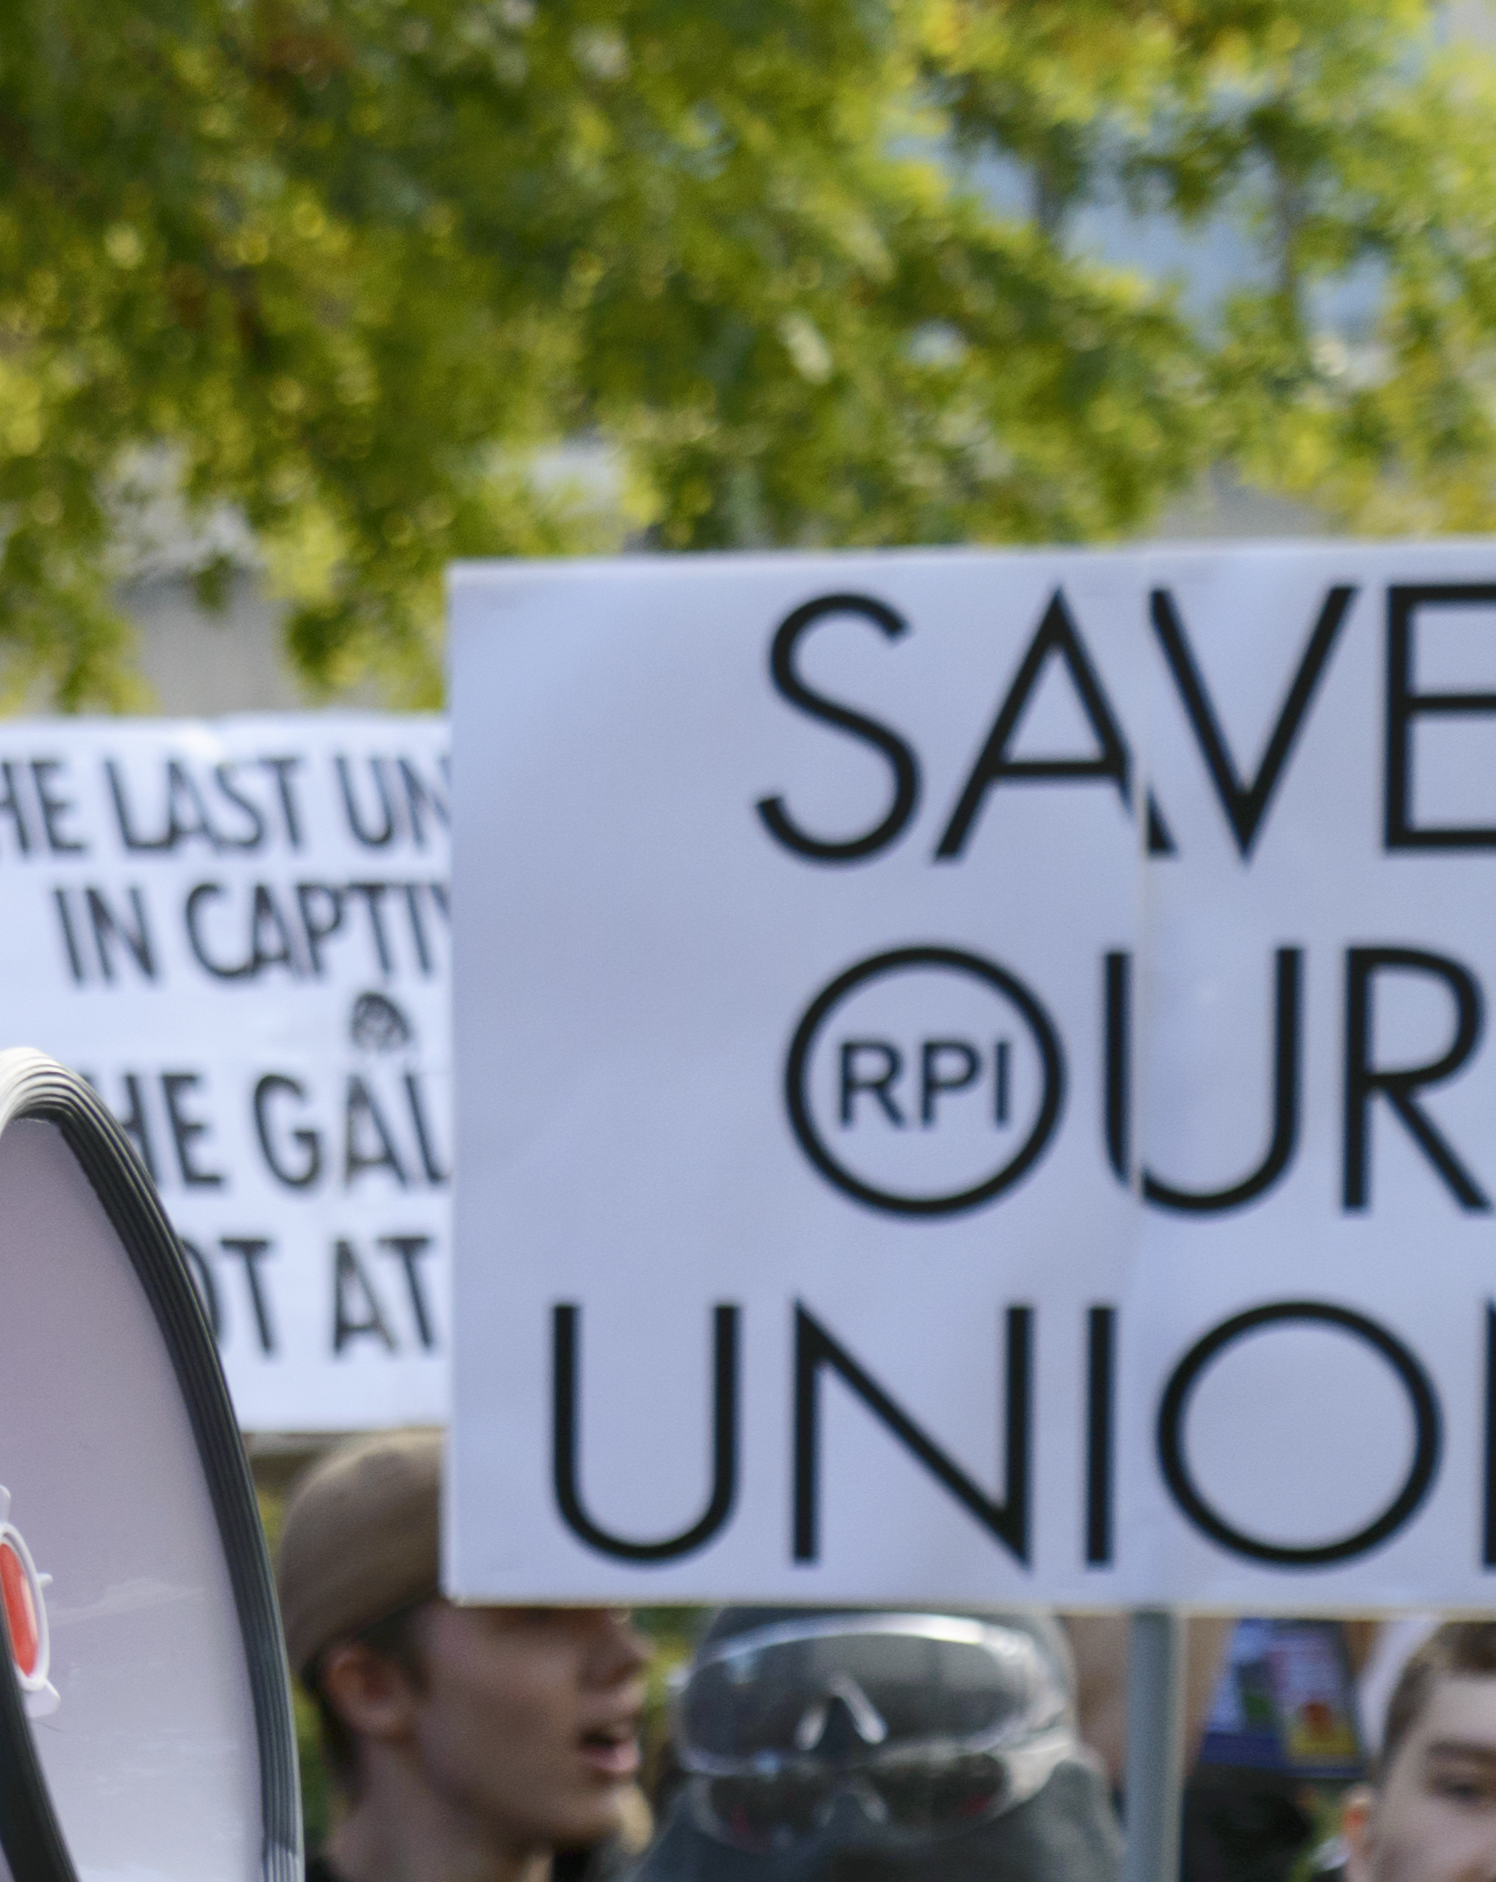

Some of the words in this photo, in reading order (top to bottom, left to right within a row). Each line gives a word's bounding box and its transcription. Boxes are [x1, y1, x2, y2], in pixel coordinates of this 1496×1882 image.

[107, 756, 305, 855] LAST
[755, 584, 1496, 867] SAVE
[53, 884, 158, 985] IN
[784, 945, 1496, 1221] OUR
[840, 1039, 1012, 1129] RPI
[549, 1295, 1496, 1574] UNIO
